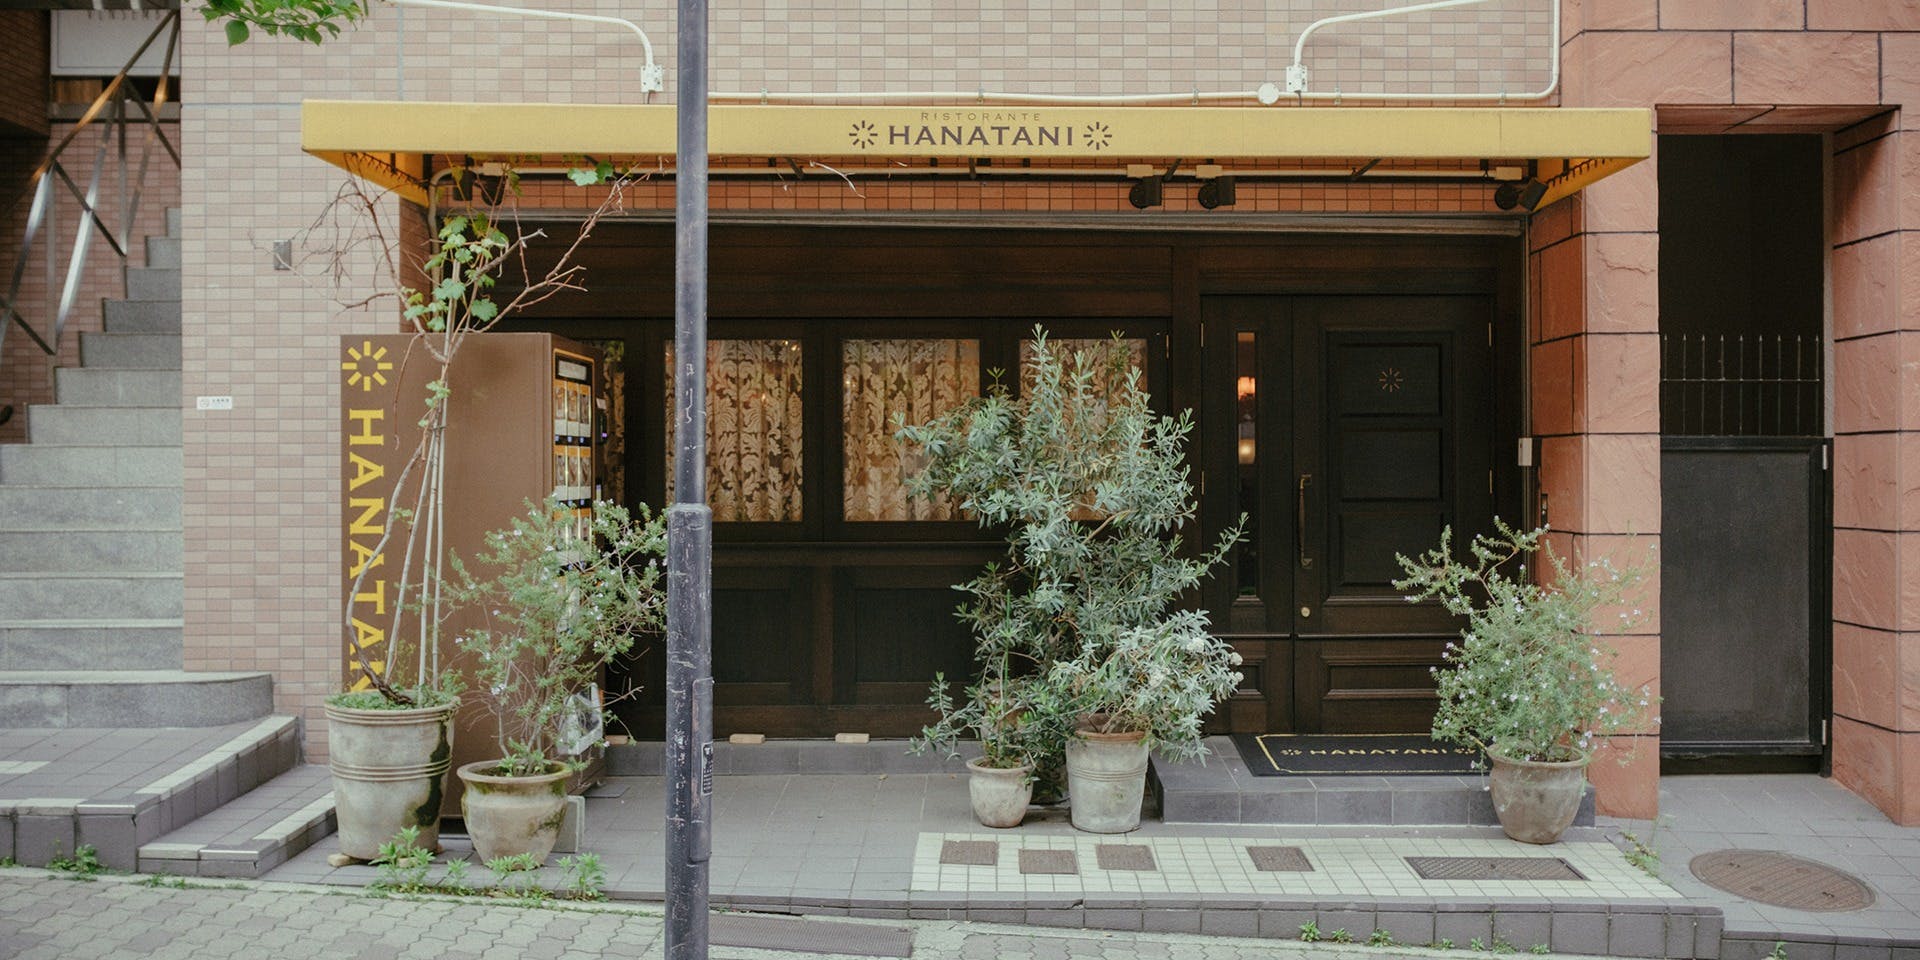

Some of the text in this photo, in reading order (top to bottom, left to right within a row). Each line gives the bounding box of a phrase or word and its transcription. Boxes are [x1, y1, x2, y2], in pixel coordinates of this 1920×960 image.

[920, 112, 1041, 121] RISTORANTE
[888, 125, 1073, 146] HANATANI
[1309, 748, 1448, 756] HANATANI
